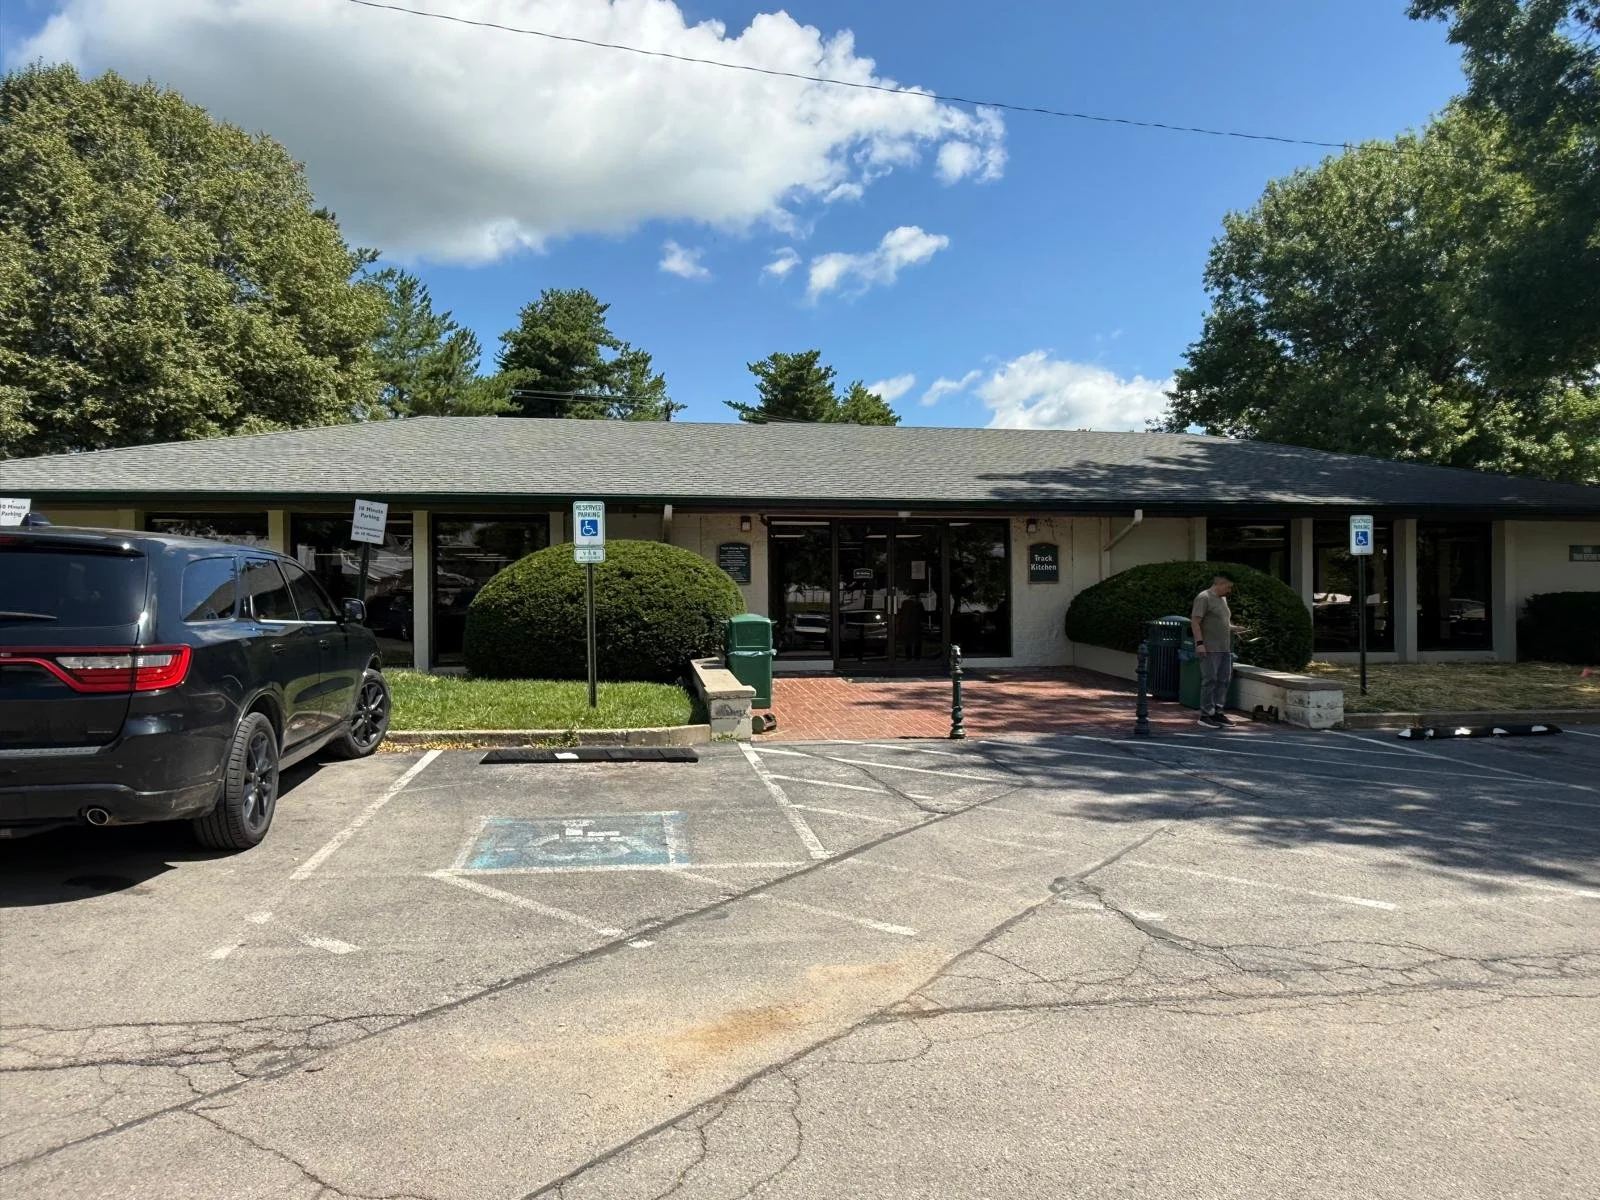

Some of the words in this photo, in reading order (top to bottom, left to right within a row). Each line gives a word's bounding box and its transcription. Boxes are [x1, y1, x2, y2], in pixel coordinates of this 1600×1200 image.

[366, 506, 383, 514] Minute
[360, 512, 380, 521] Parking
[1034, 554, 1053, 562] Track
[1030, 563, 1057, 571] Kitchen
